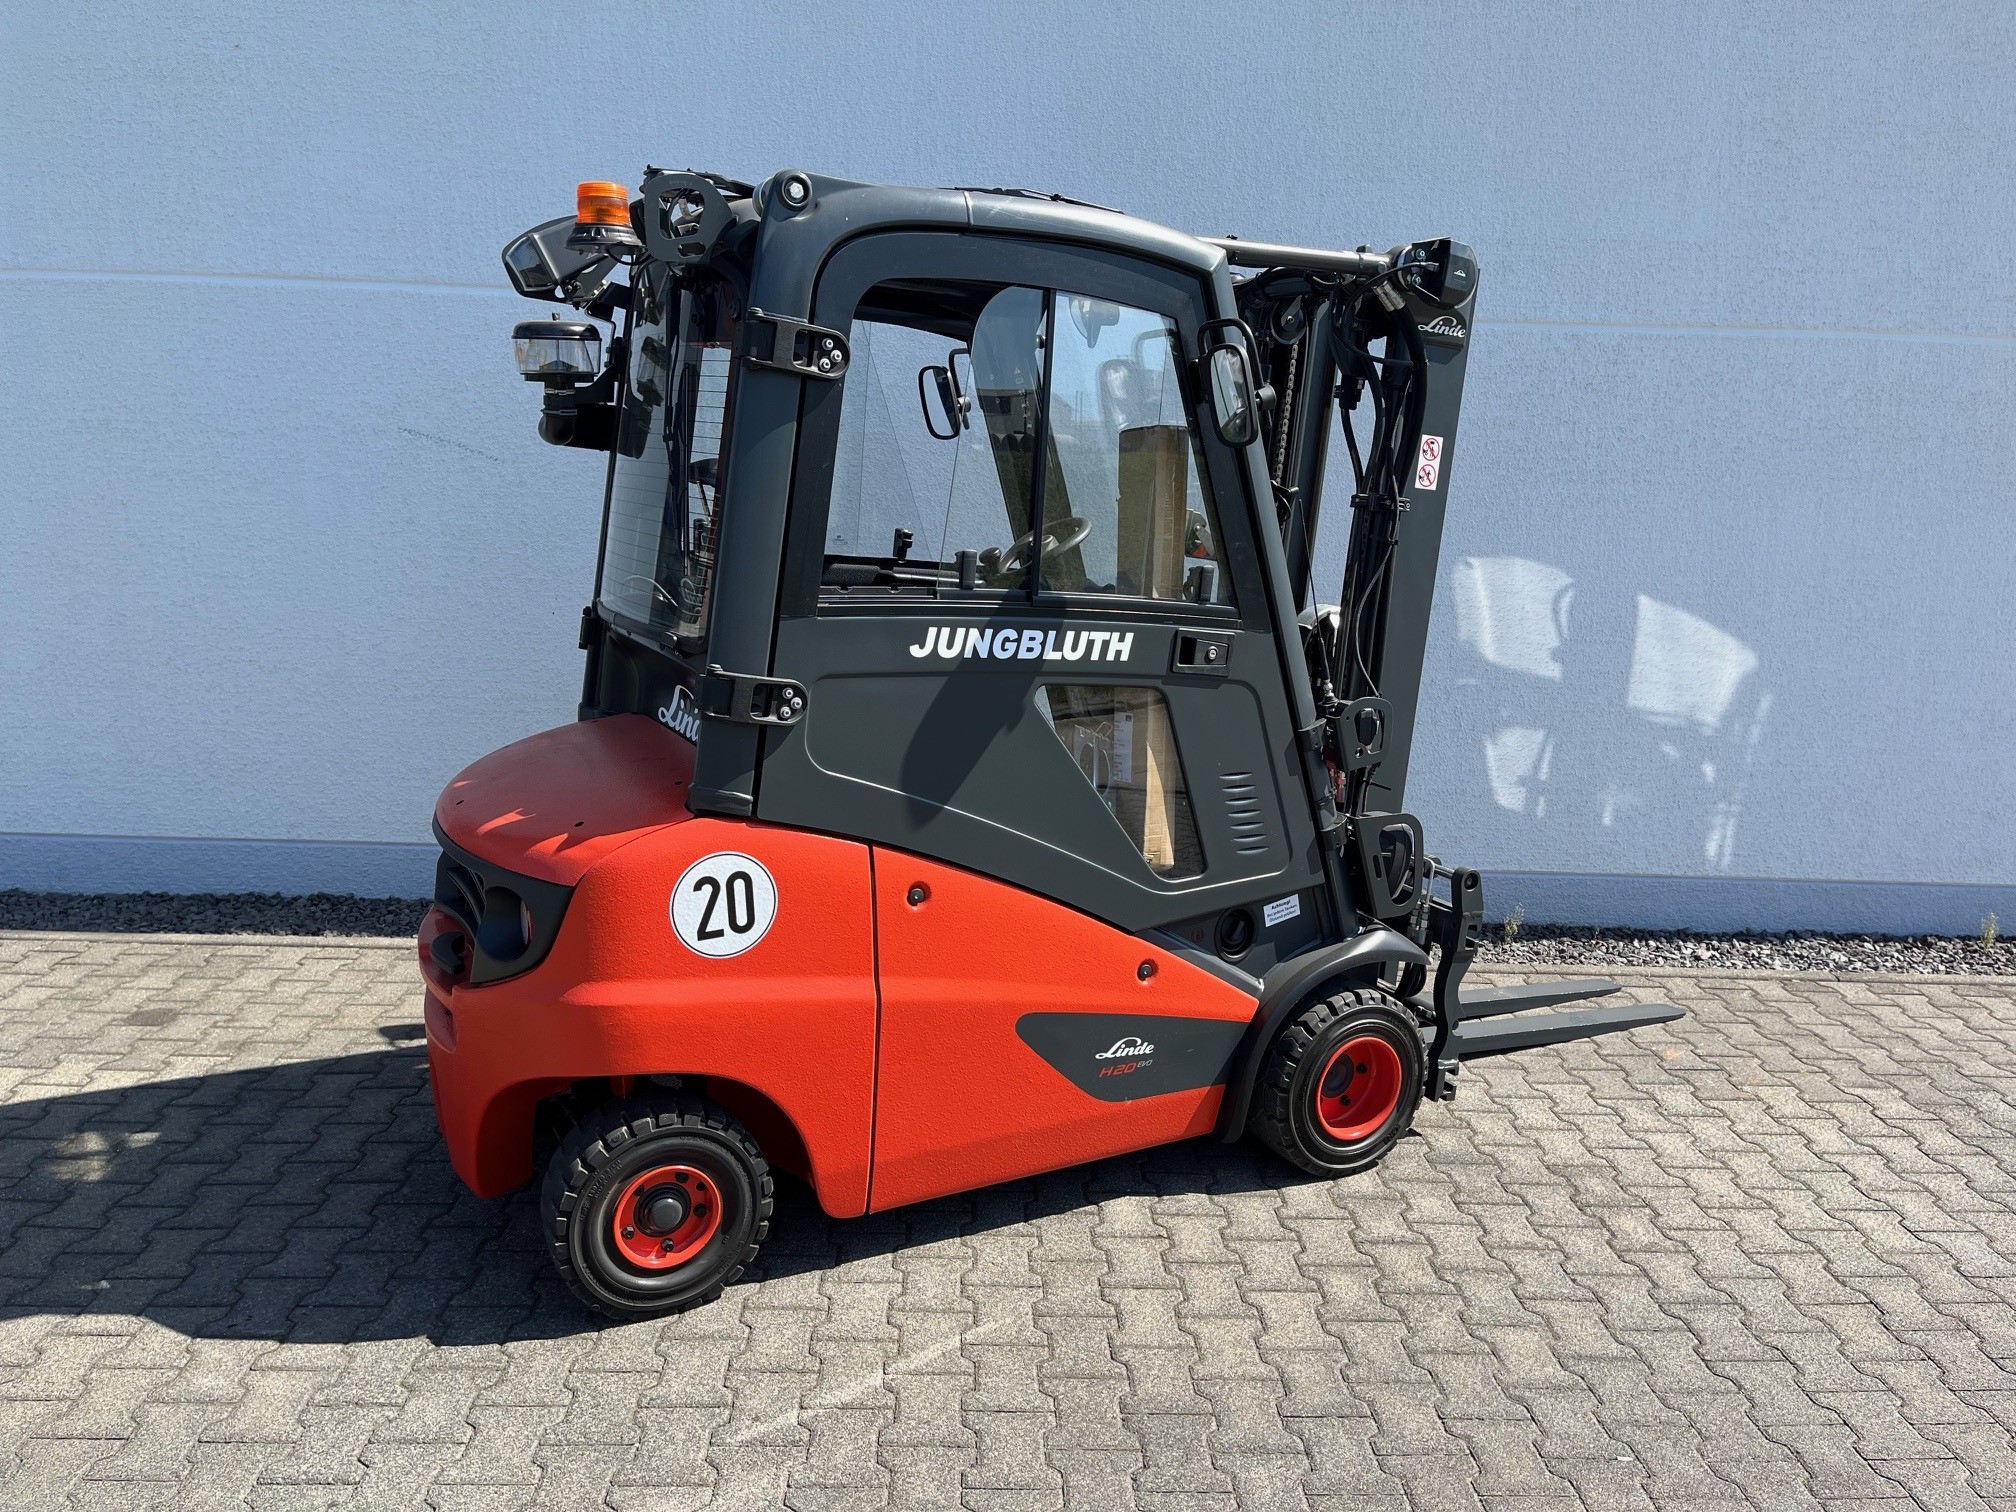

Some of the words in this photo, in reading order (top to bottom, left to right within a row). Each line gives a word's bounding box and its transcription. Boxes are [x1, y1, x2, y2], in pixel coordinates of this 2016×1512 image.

[1418, 315, 1466, 338] Linde
[909, 626, 1135, 662] JUNGBLUTH
[658, 684, 700, 742] Lin
[693, 870, 756, 942] 20
[1095, 1036, 1155, 1060] Linde
[1099, 1061, 1137, 1078] H20
